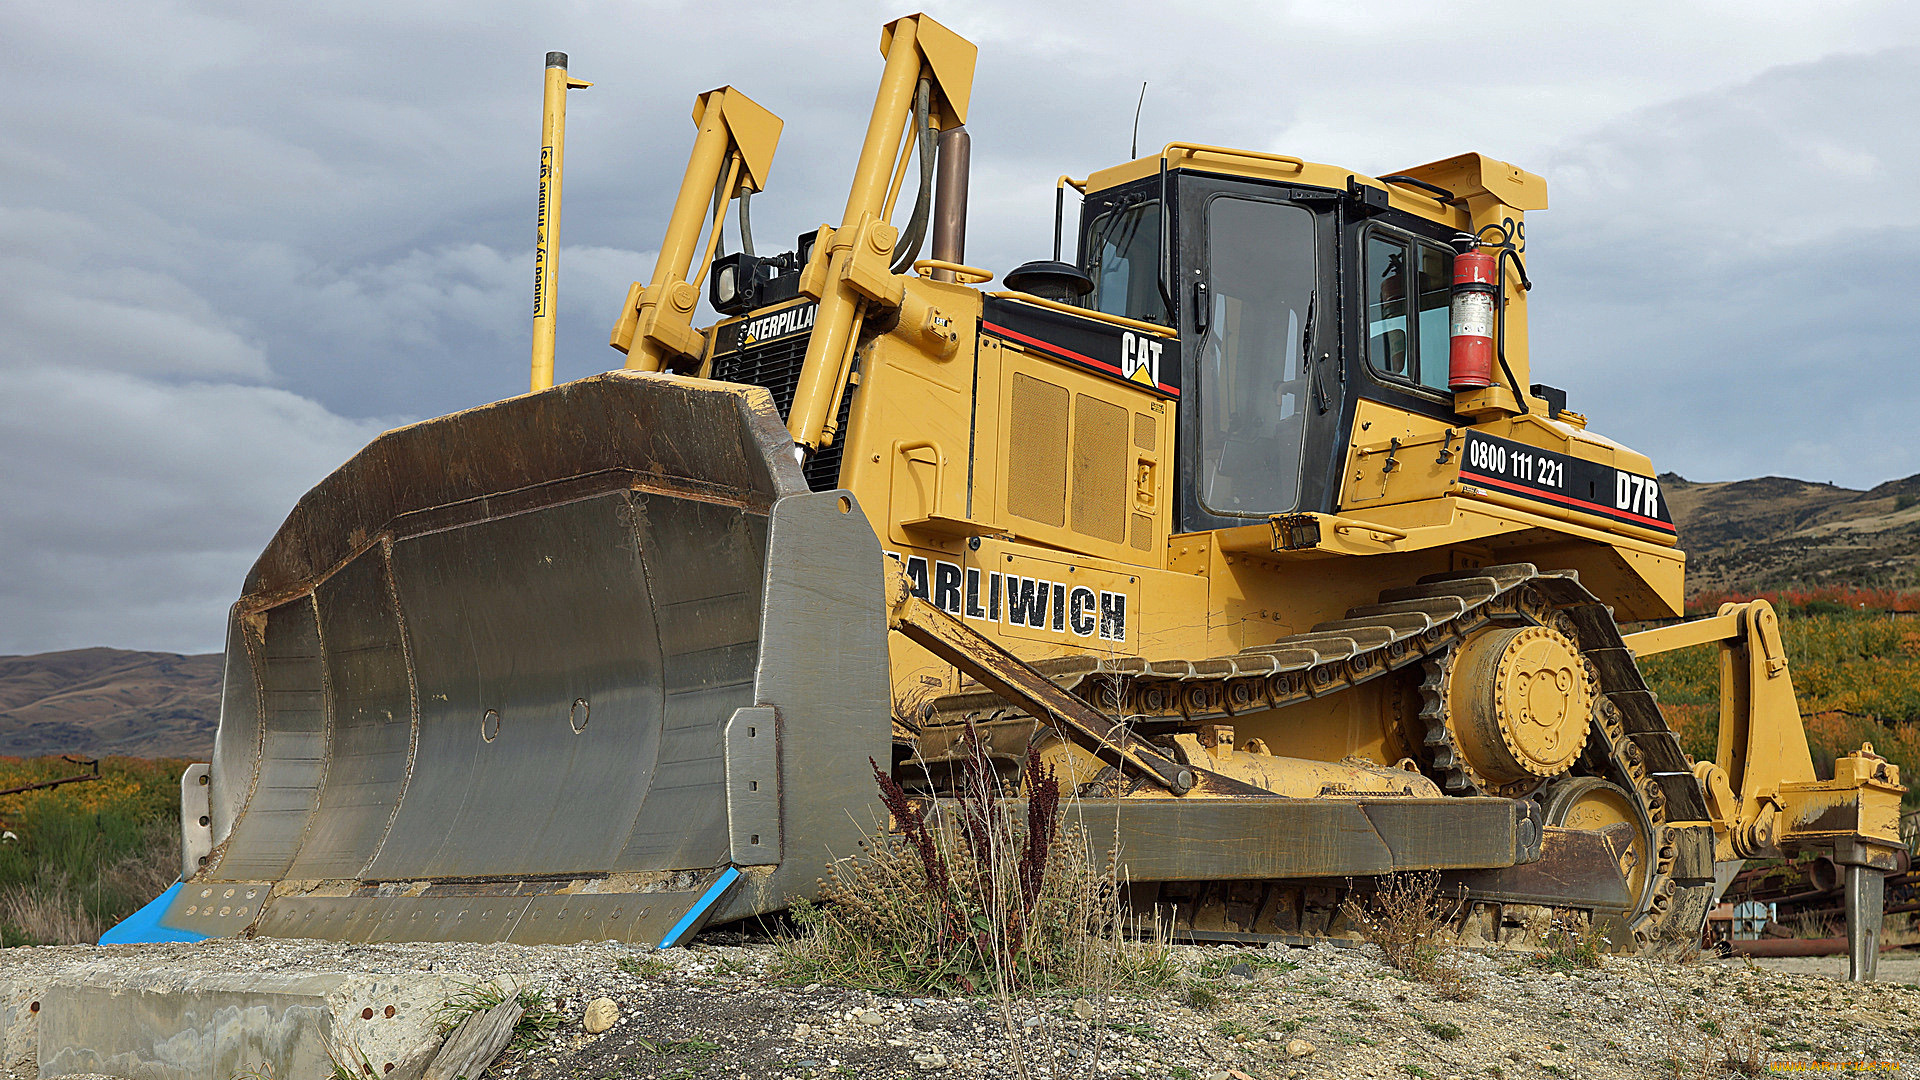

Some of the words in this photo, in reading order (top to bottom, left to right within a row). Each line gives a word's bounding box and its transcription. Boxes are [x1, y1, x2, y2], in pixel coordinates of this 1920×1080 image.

[1502, 216, 1526, 254] 29
[1121, 331, 1163, 388] CAT
[1470, 439, 1507, 474] 0800
[1510, 450, 1532, 481] 111
[1537, 457, 1563, 488] 221
[1616, 470, 1659, 519] D7R
[881, 549, 1127, 643] ARLIWICH
